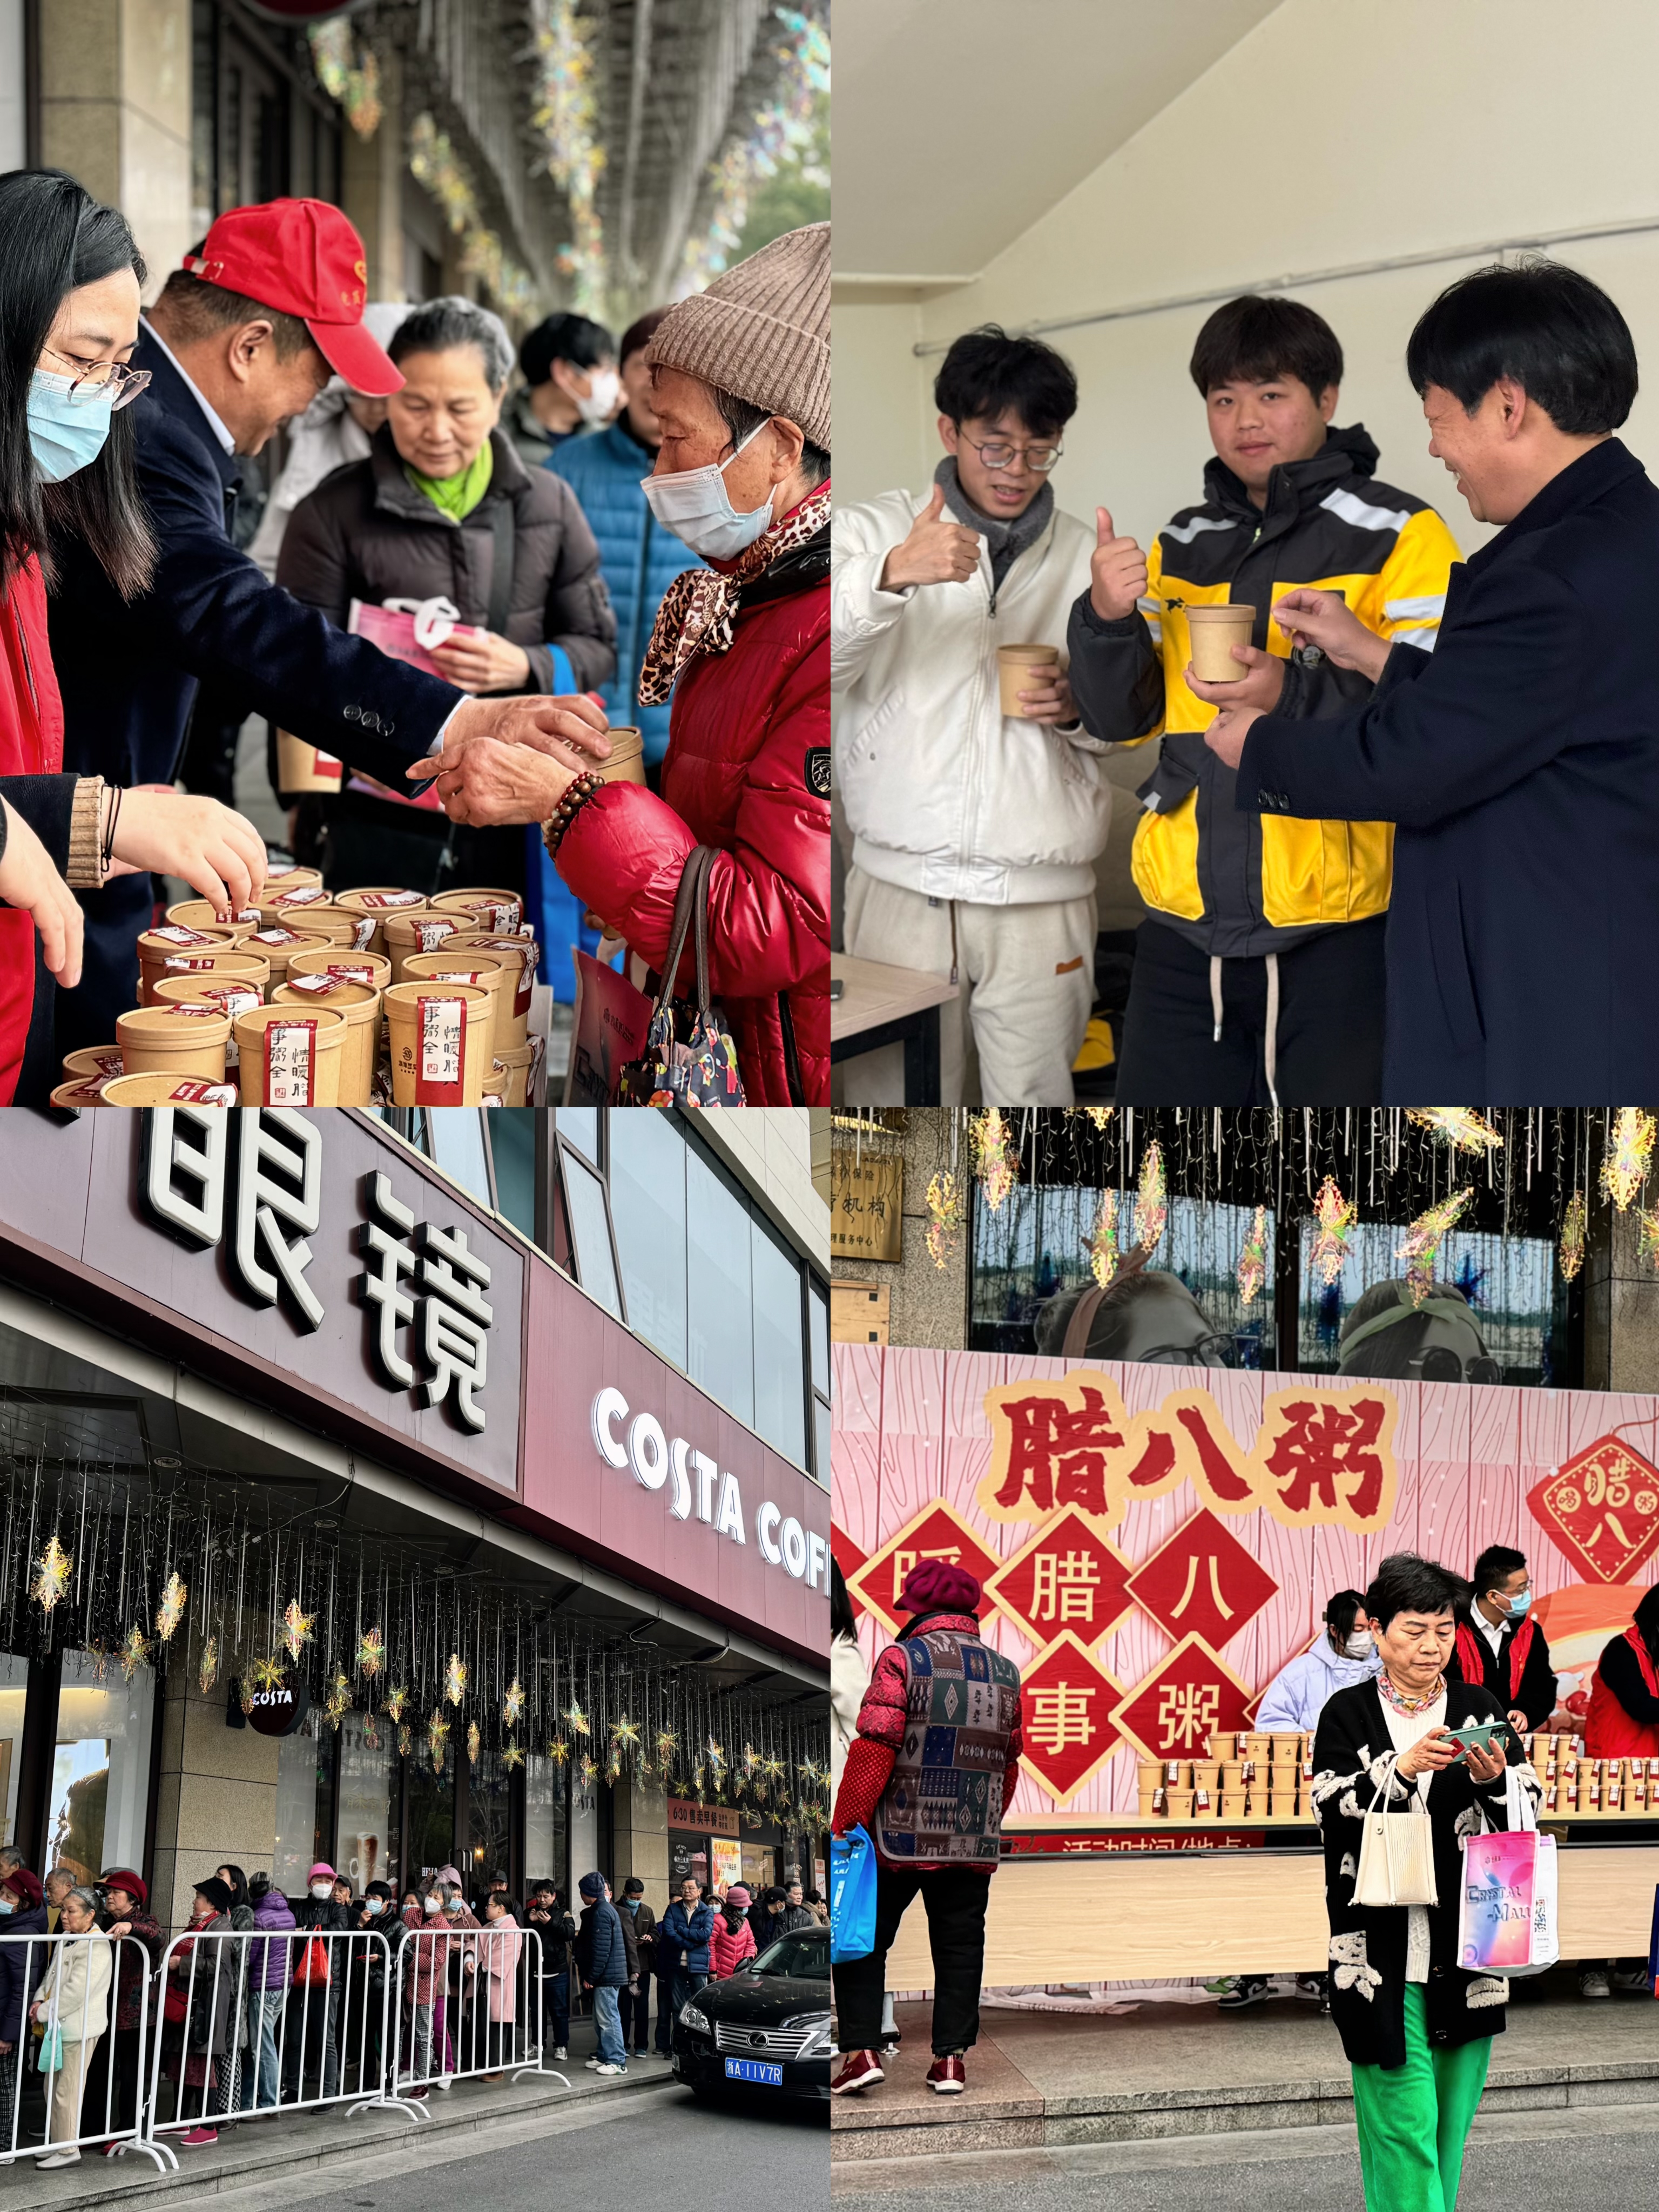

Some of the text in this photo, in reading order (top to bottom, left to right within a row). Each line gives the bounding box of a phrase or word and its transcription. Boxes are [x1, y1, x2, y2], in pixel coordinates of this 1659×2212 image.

[593, 1387, 746, 1545] COSTA
[994, 1386, 1386, 1519] 腊八粥
[252, 1690, 293, 1707] COSTA
